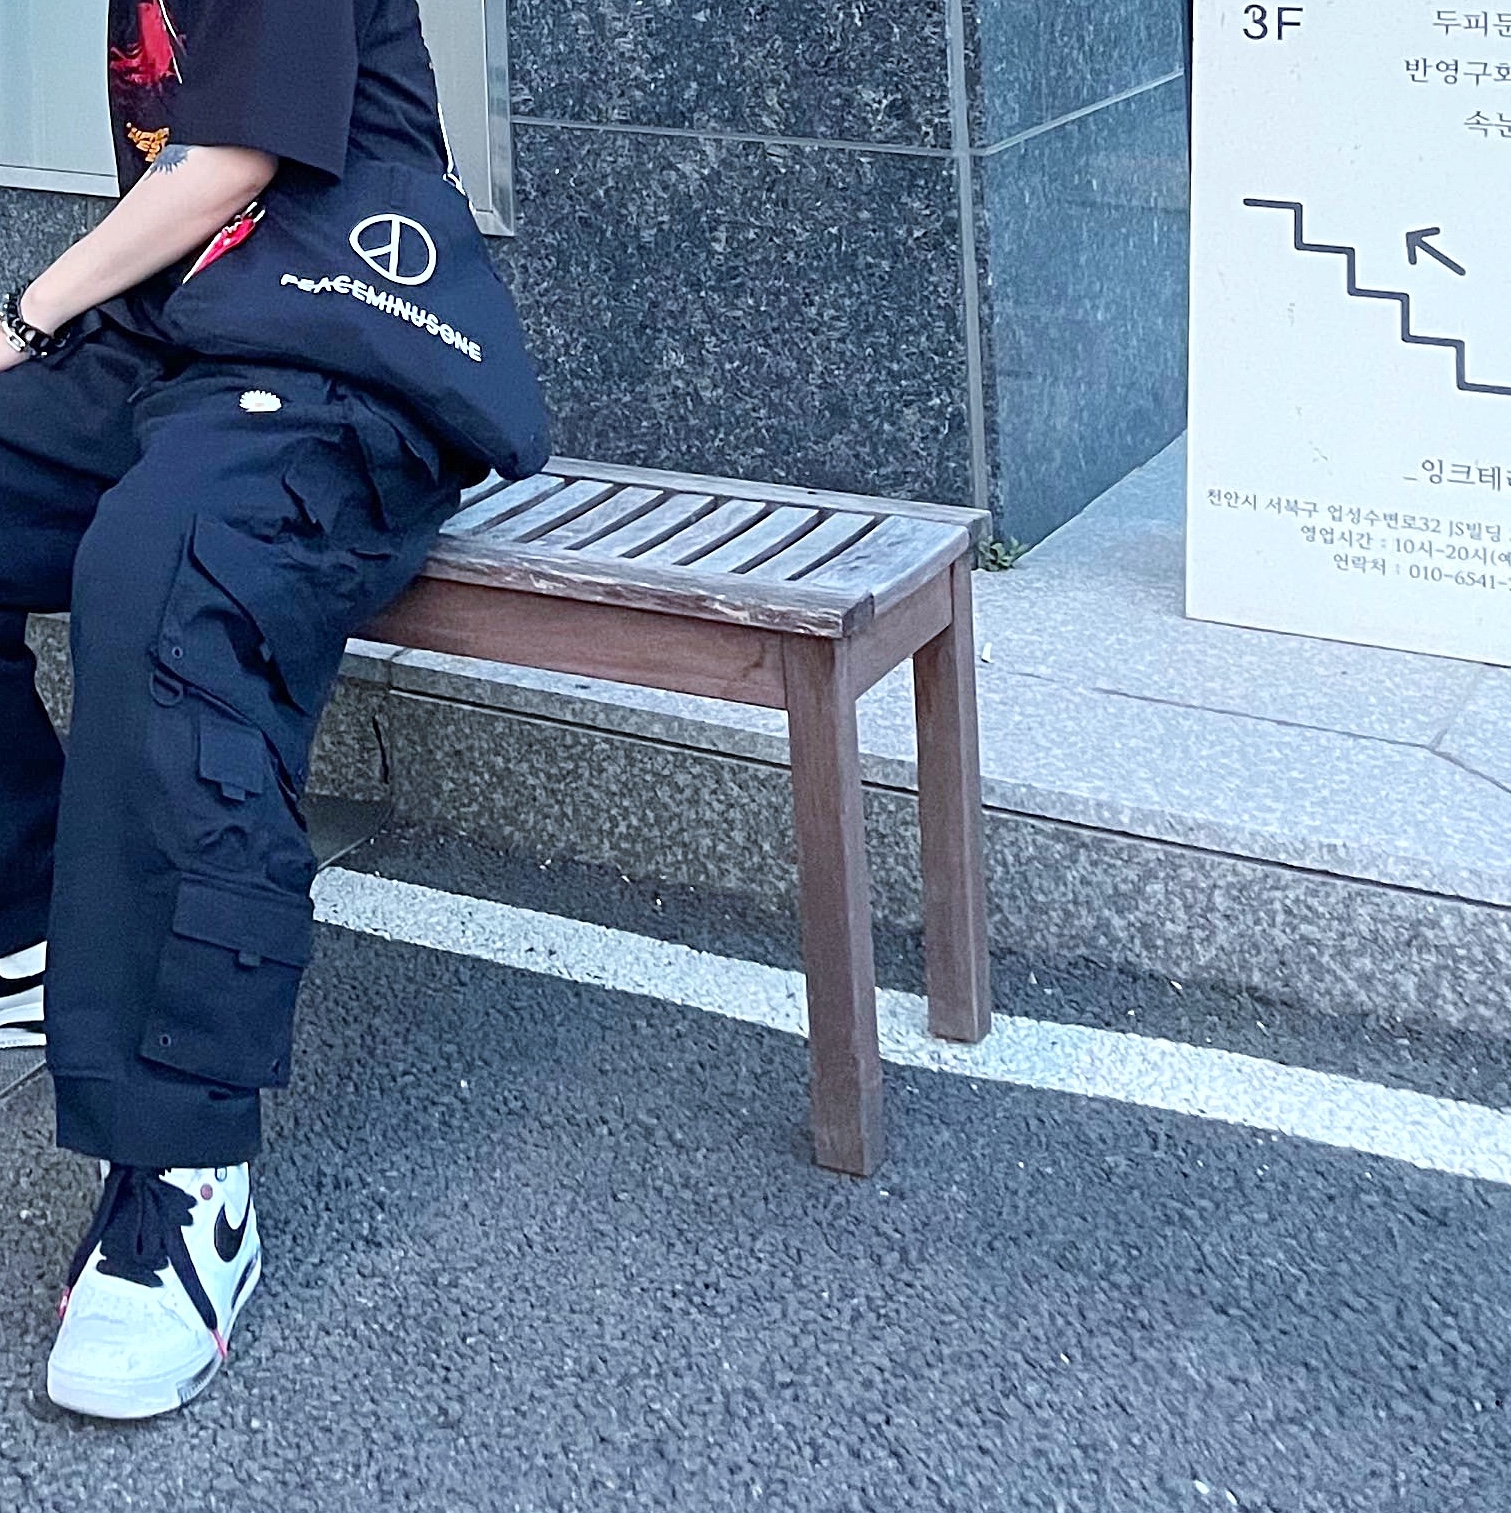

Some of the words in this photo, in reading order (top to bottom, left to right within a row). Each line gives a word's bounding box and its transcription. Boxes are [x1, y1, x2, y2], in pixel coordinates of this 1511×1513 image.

[1243, 4, 1303, 40] 3F
[280, 273, 482, 362] PEACEMINUSONE
[1301, 525, 1374, 551] 영업시간
[1409, 564, 1511, 590] 010-6541-
